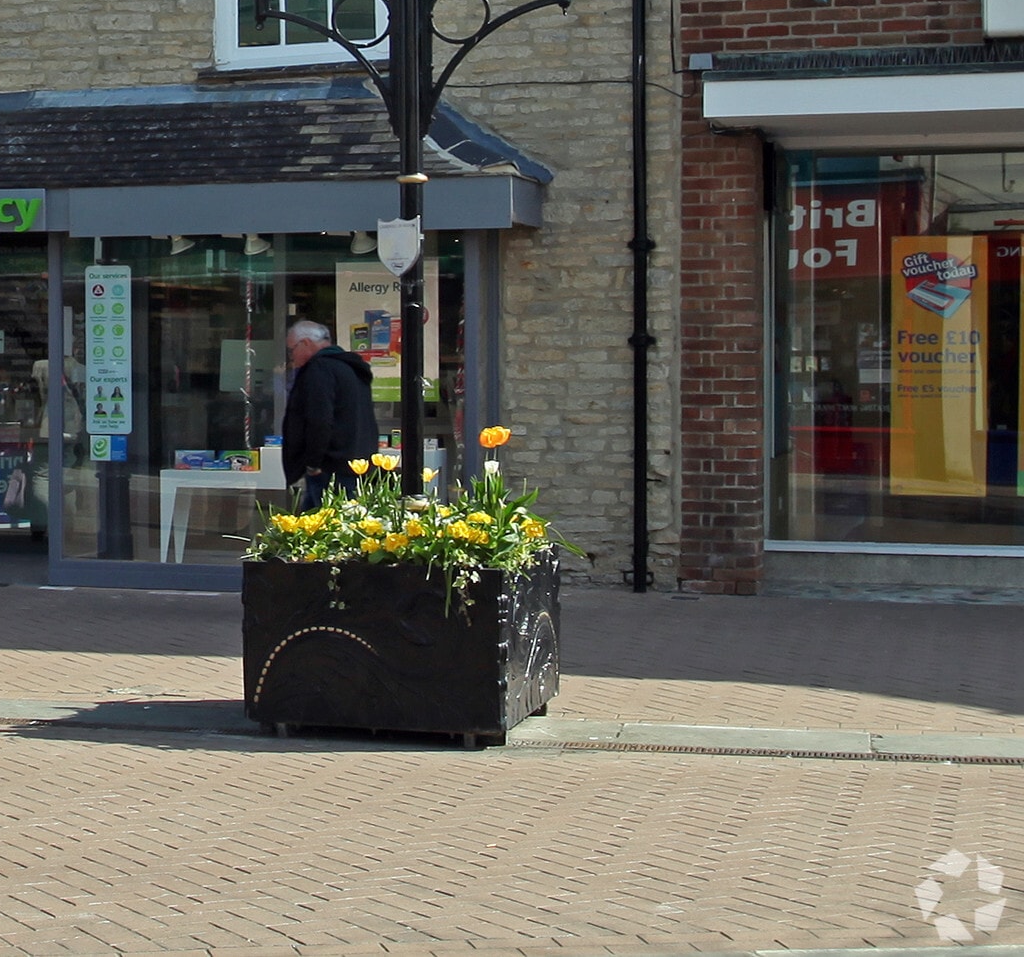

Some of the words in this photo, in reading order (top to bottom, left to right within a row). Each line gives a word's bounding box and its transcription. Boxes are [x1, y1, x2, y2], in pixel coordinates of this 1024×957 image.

[903, 258, 954, 277] voucher
[904, 253, 929, 268] Gift
[937, 265, 976, 281] today
[349, 283, 389, 295] Allergy
[898, 330, 938, 345] Free
[946, 330, 980, 345] £10
[898, 348, 976, 363] voucher
[104, 376, 127, 384] experts
[897, 384, 918, 392] Free
[938, 384, 977, 393] voucher
